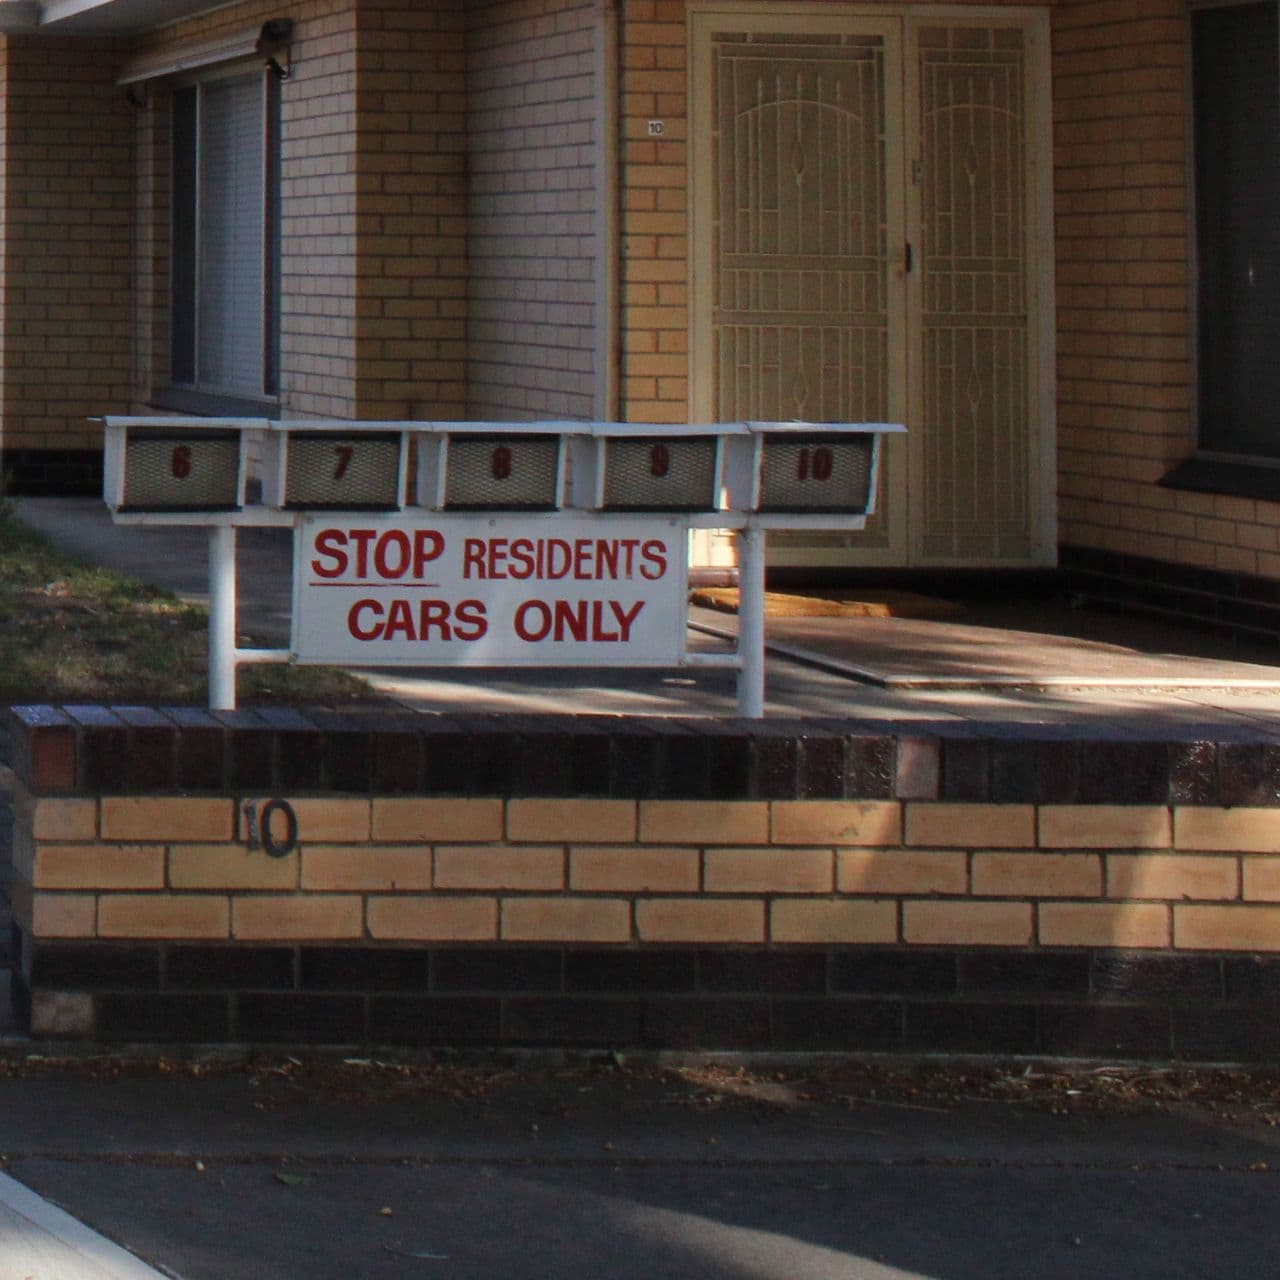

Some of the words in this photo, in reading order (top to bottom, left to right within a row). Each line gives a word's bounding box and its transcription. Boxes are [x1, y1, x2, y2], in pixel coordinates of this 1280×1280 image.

[649, 122, 663, 134] 10
[172, 446, 190, 479] 6
[334, 446, 353, 480] 7
[492, 447, 512, 480] 8
[650, 444, 670, 477] 9
[797, 447, 833, 481] 10
[311, 528, 445, 580] STOP
[462, 538, 668, 581] RESIDENTS
[347, 598, 489, 642] CARS
[513, 599, 645, 643] ONLY
[243, 800, 298, 858] 10
